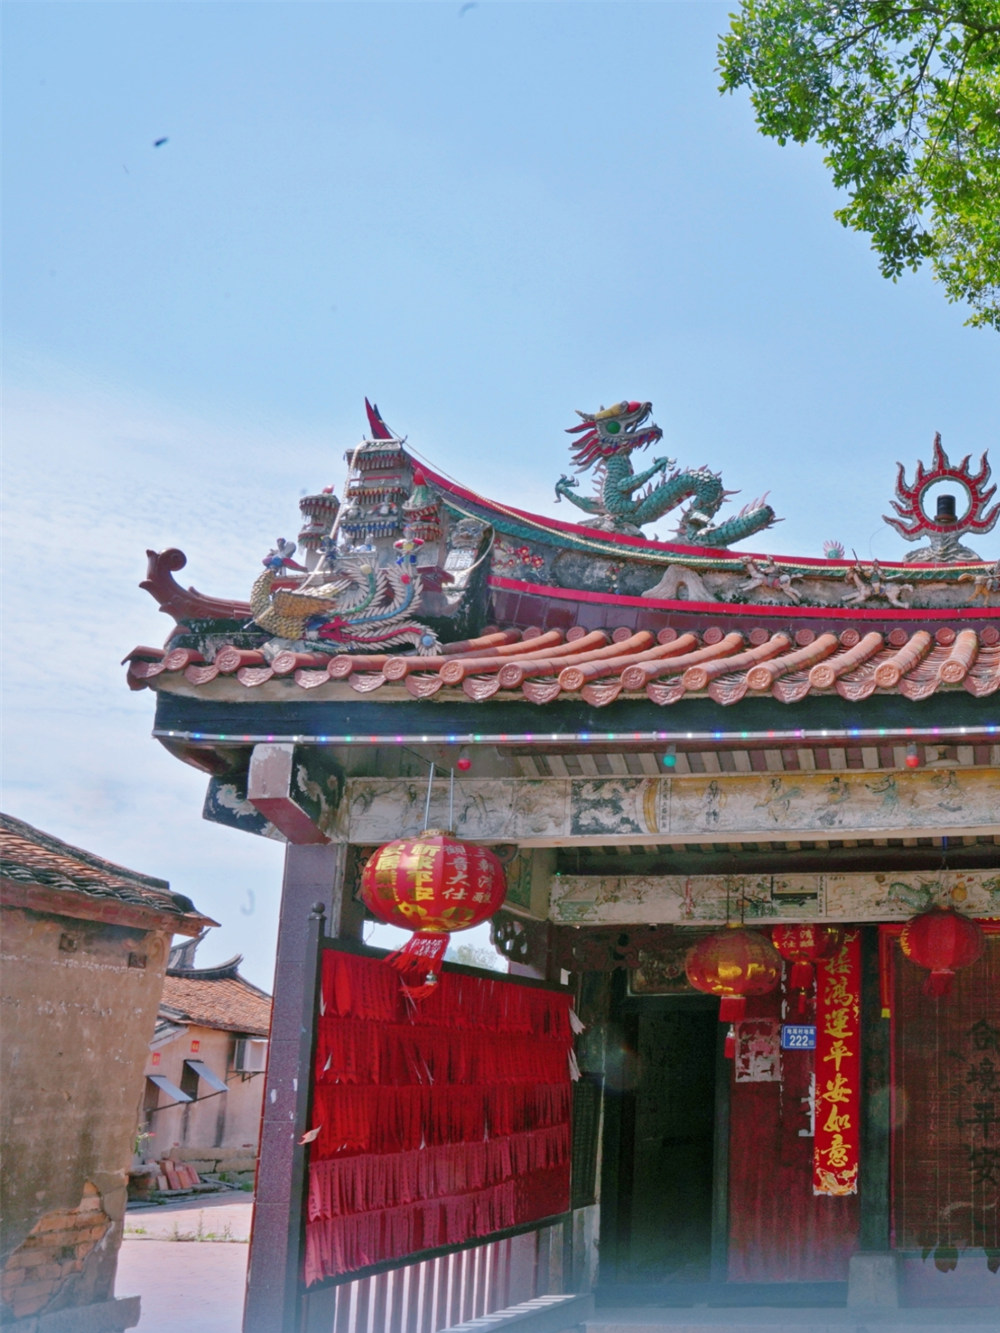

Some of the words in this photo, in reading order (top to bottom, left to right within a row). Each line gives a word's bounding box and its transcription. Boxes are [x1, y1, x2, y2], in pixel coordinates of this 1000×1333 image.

[822, 932, 859, 1168] 接鴻運平安如意
